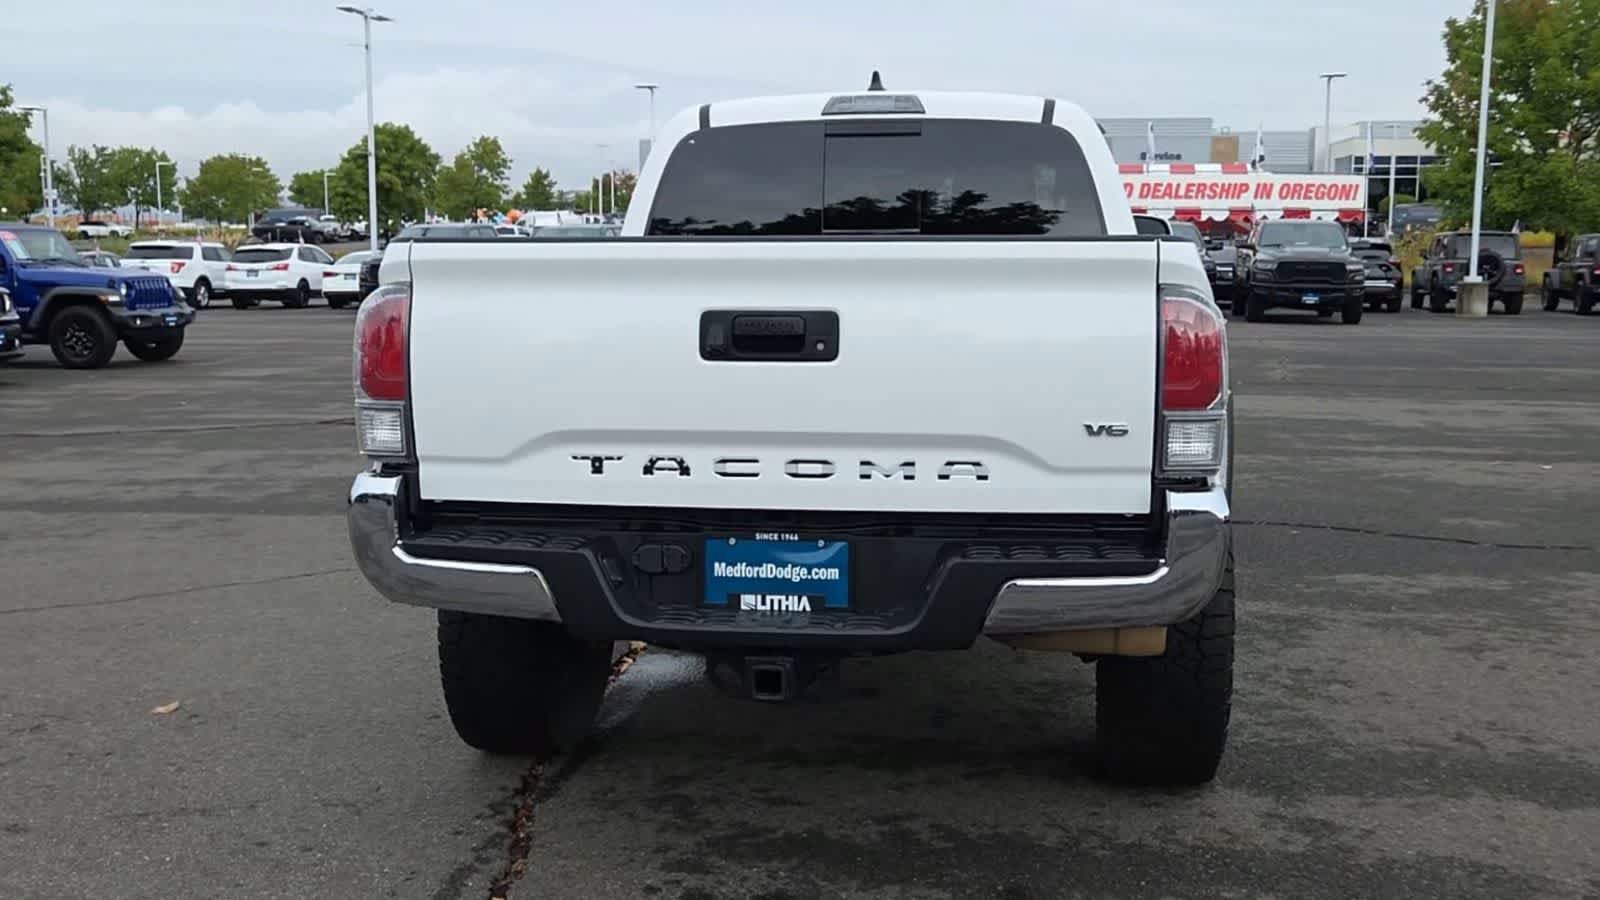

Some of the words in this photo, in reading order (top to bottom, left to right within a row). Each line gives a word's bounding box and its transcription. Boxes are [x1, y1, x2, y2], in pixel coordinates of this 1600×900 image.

[1140, 152, 1182, 160] Srvice
[1139, 182, 1250, 200] DEALERSHIP
[1254, 183, 1273, 199] IN
[1279, 183, 1360, 201] OREGON!
[1083, 423, 1129, 437] V6
[571, 455, 990, 481] TACOMA
[755, 532, 779, 541] SINCE
[714, 562, 839, 582] MedfordDodge.com
[756, 594, 811, 611] LITHIA
